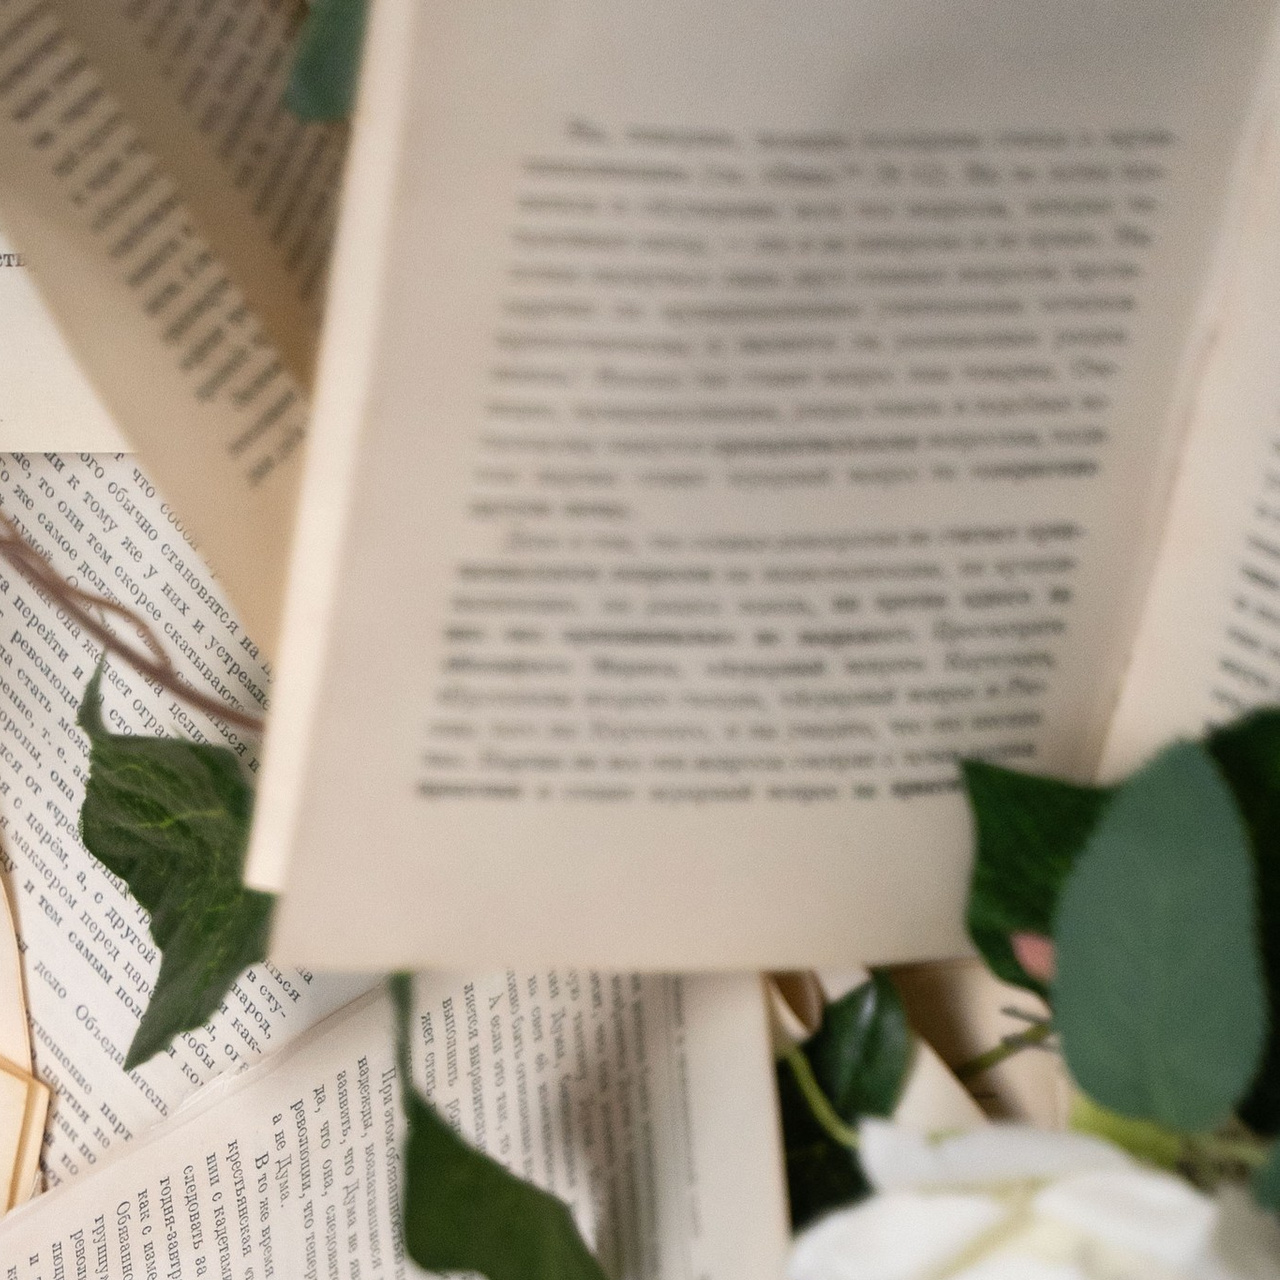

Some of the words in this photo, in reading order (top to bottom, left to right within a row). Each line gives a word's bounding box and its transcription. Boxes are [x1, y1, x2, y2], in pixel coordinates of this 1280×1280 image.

[133, 468, 155, 498] что
[38, 477, 55, 498] то
[57, 500, 85, 533] они
[86, 532, 113, 565] тем
[114, 566, 162, 621] скорее
[67, 474, 80, 491] к
[83, 491, 118, 533] тому
[121, 536, 143, 563] же
[143, 564, 158, 579] у
[161, 582, 190, 617] них
[192, 619, 205, 634] и
[108, 482, 158, 541] обычно
[161, 543, 239, 635] становятся
[239, 636, 259, 661] на
[17, 668, 52, 713] стать
[50, 770, 74, 802] она
[14, 797, 22, 806] с
[26, 812, 68, 869] царём,
[76, 871, 87, 892] а,
[94, 892, 104, 904] с
[105, 907, 155, 964] другой
[23, 879, 35, 894] и
[38, 895, 63, 926] тем
[68, 931, 113, 985] самым
[34, 962, 67, 998] дело
[231, 1017, 262, 1054] как-
[100, 1102, 133, 1142] парт
[29, 1253, 39, 1266] и
